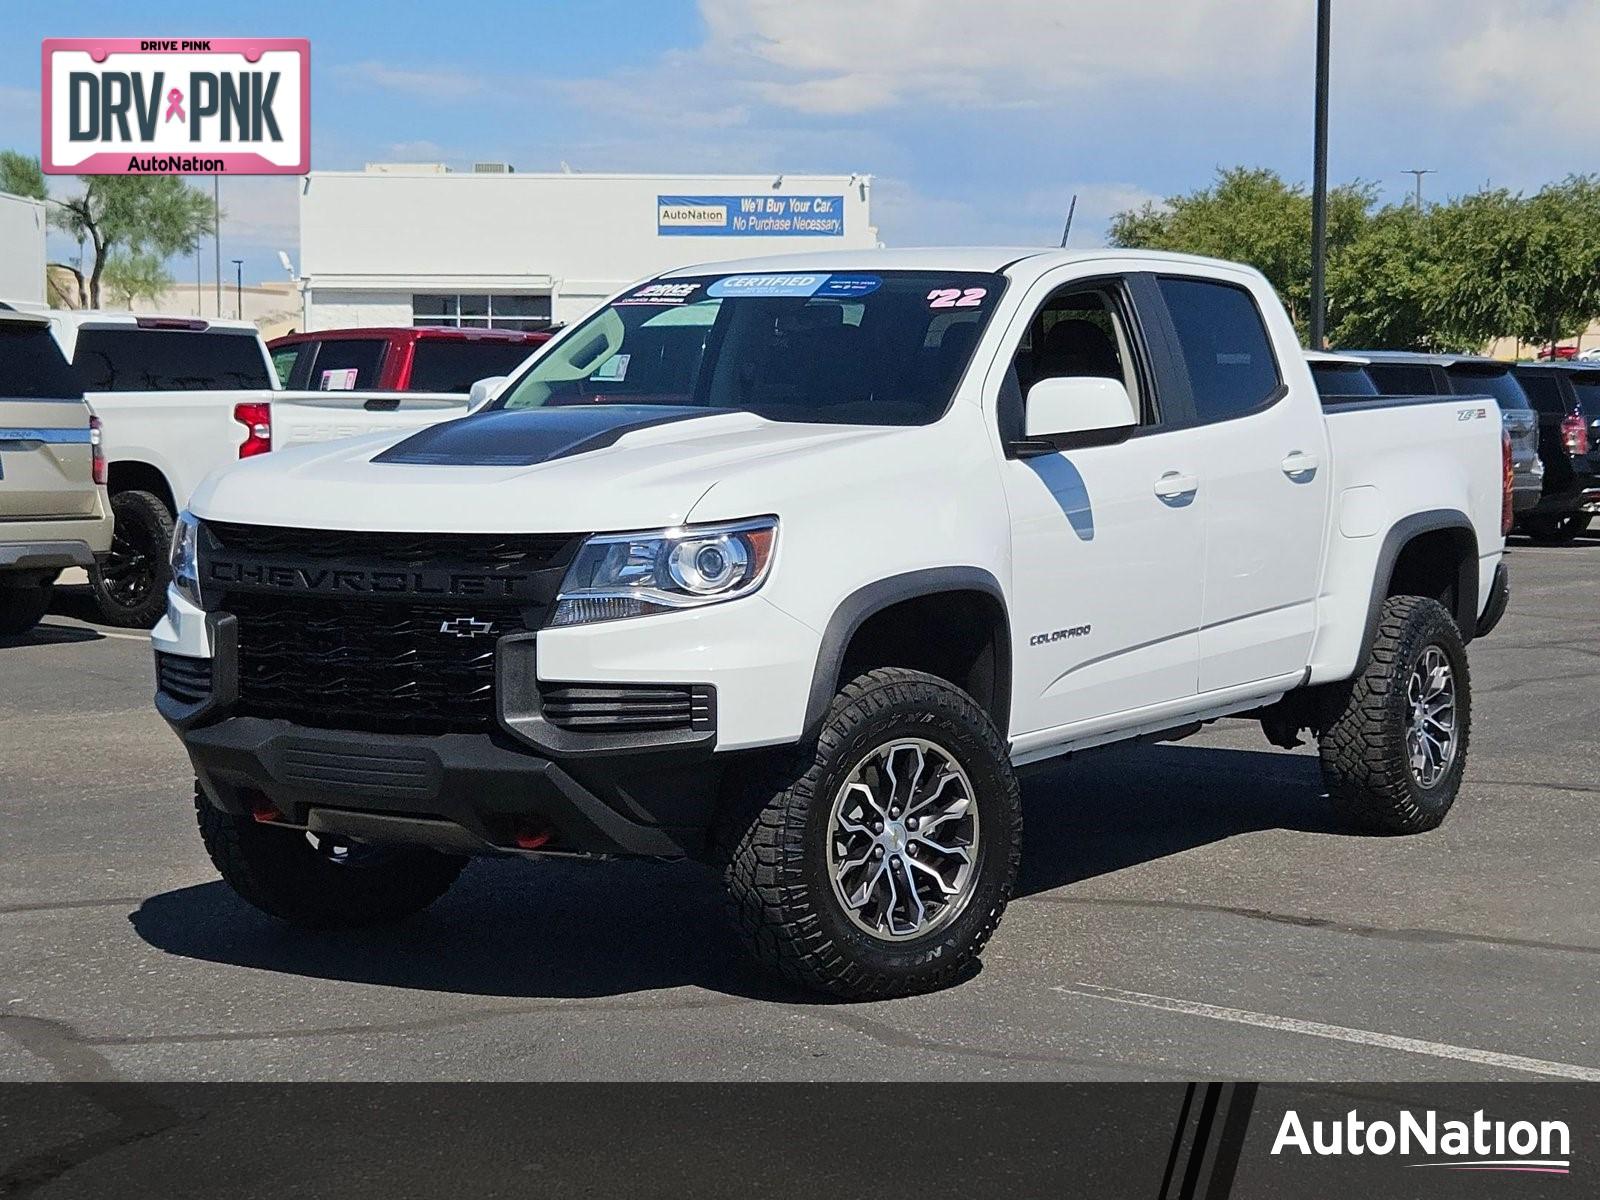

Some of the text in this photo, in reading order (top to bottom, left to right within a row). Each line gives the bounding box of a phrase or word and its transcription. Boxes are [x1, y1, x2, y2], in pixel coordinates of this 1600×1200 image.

[663, 209, 723, 220] AutoNation
[741, 198, 833, 215] We'll Buy Your Car.
[733, 217, 841, 235] No Purchase Necessary.
[723, 276, 816, 288] CERTIFIED
[211, 561, 528, 596] CHEVROLET
[1030, 624, 1092, 646] COLORADO
